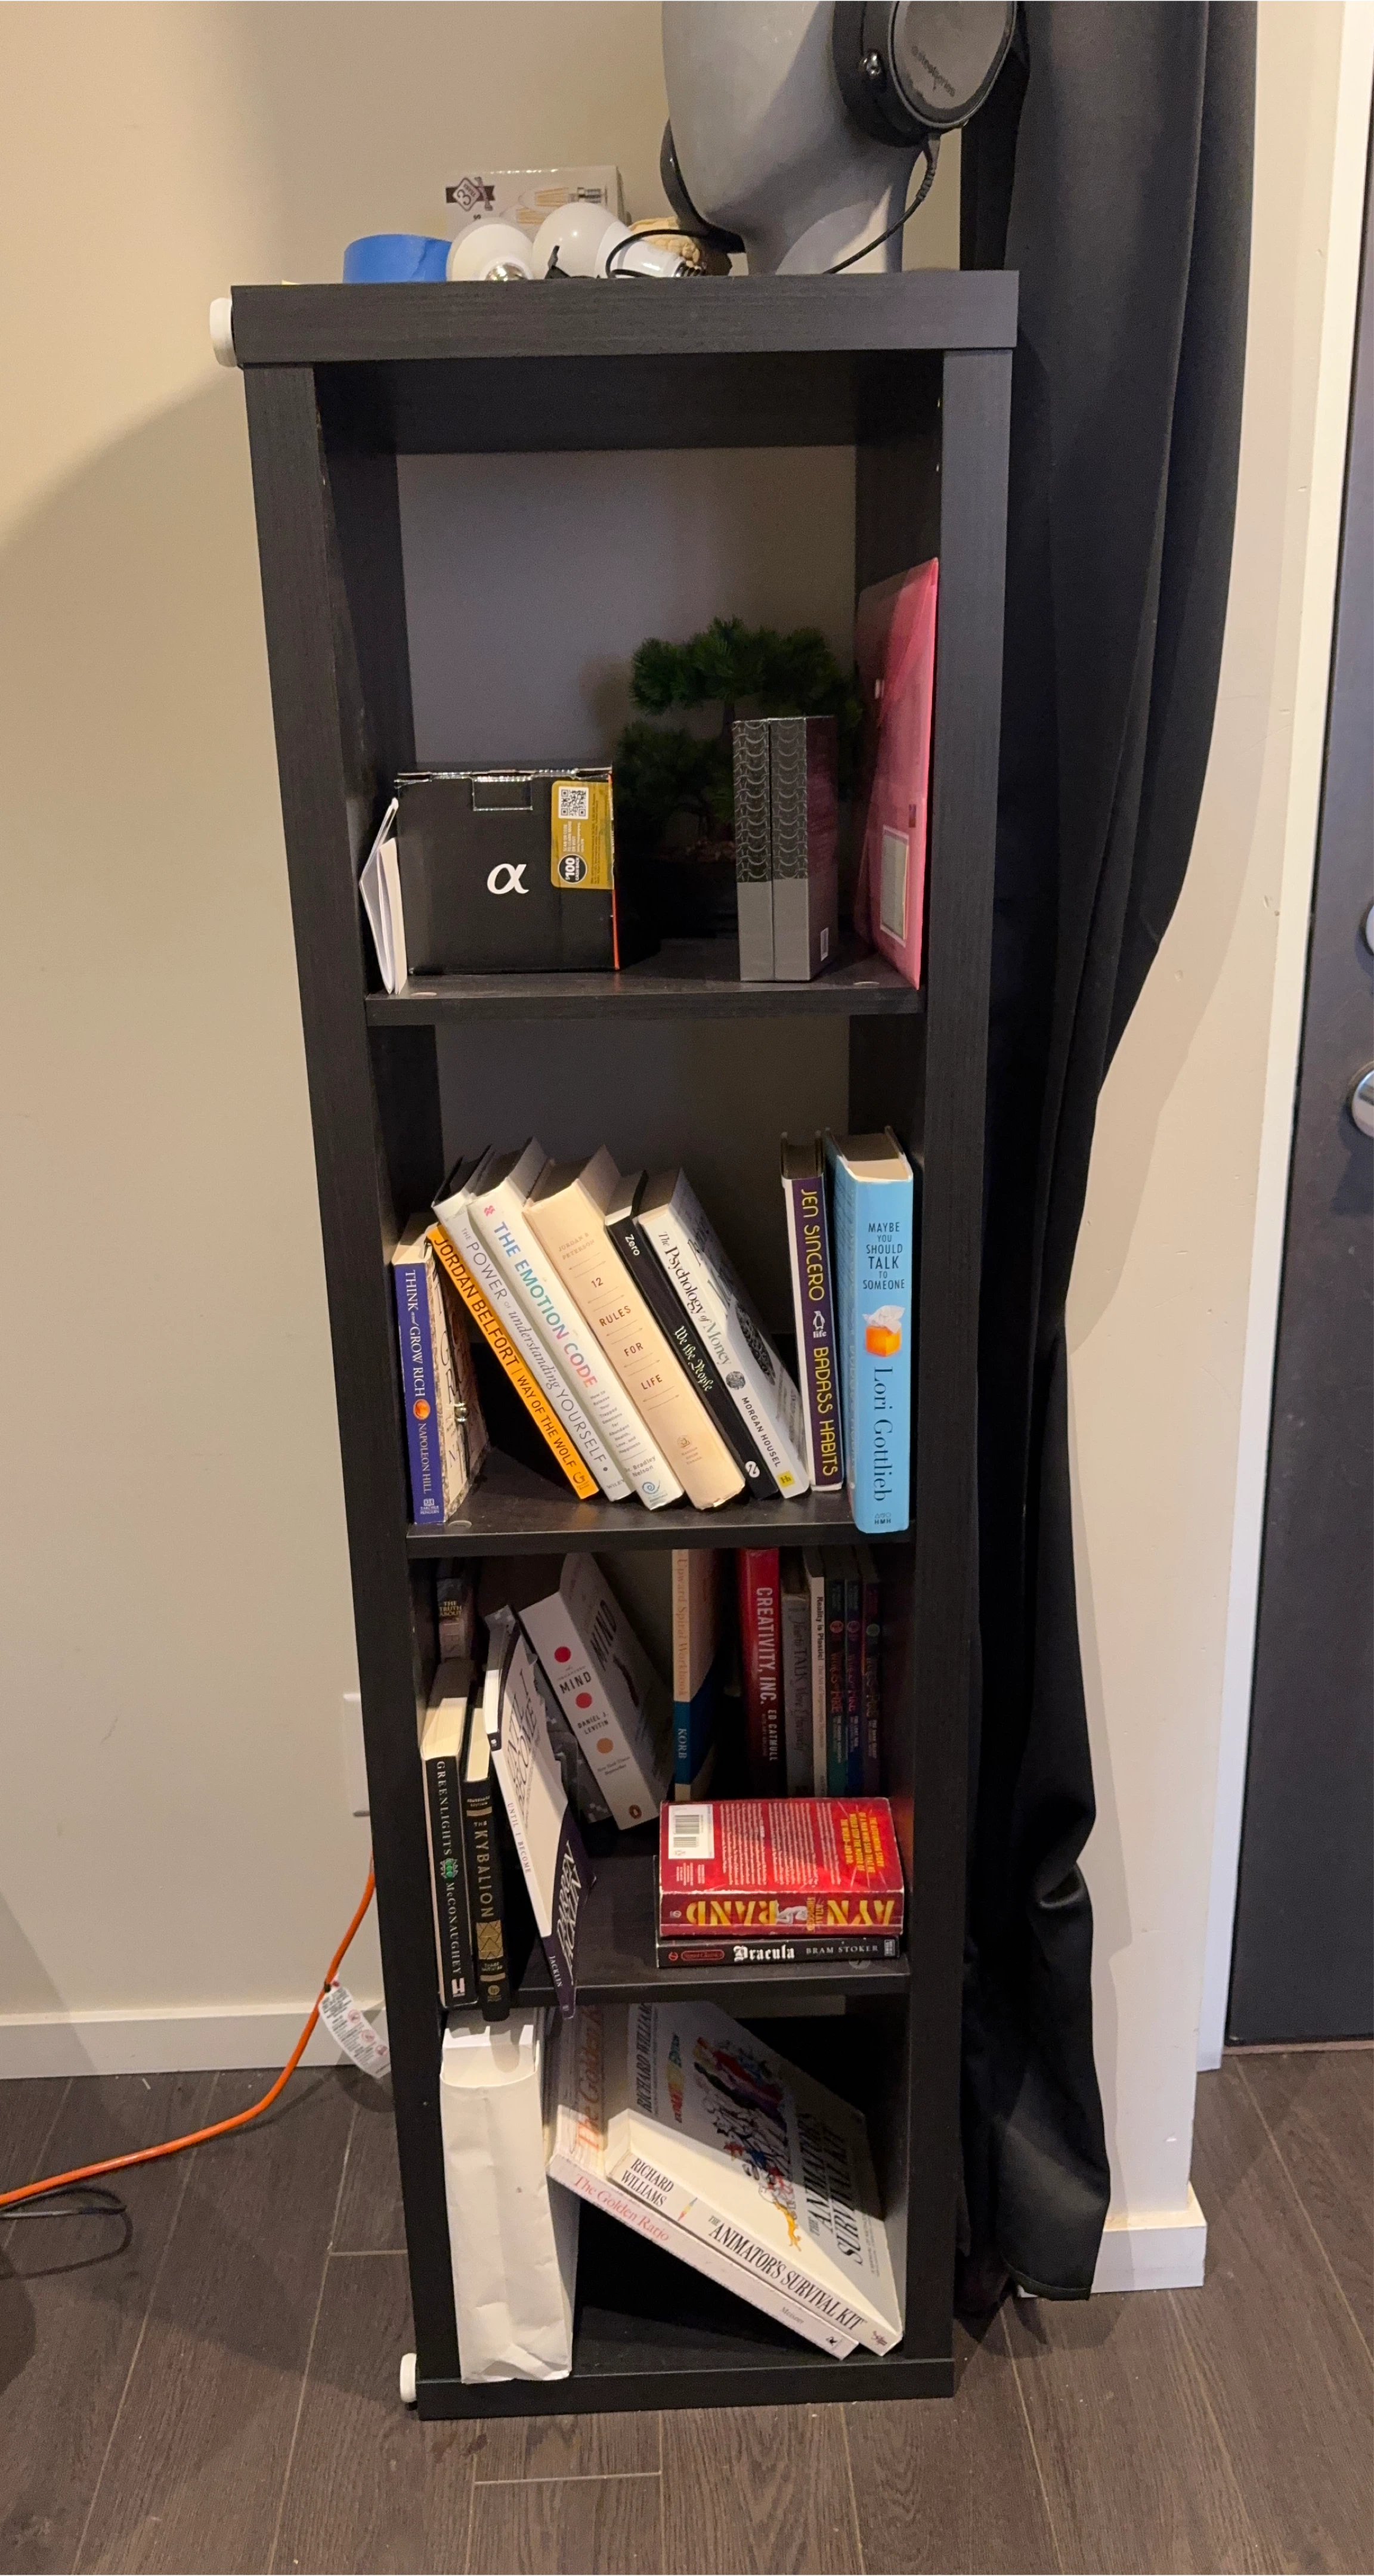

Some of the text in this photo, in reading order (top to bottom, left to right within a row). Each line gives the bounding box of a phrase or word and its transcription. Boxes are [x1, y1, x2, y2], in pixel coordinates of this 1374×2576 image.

[565, 857, 575, 880] $100
[461, 1227, 472, 1241] THE
[868, 1222, 900, 1233] MAYBE
[558, 1235, 584, 1252] JORDAN
[562, 1239, 595, 1260] PETERSON
[625, 1234, 640, 1256] Zero
[802, 1188, 825, 1301] JEN SINCERO
[866, 1243, 903, 1254] SHOULD
[466, 1241, 507, 1299] POWER
[868, 1256, 899, 1269] TALK
[591, 1277, 604, 1288] 12
[862, 1279, 905, 1290] SOMEONE
[494, 1221, 598, 1388] THE EMOTION CODE
[658, 1231, 731, 1366] The Psychology of Money
[599, 1305, 632, 1327] RULES
[406, 1270, 426, 1397] THINK GROW RICH
[434, 1239, 478, 1299] JORDAN
[471, 1299, 519, 1367] BELFORT
[517, 1375, 536, 1398] WAY
[531, 1400, 546, 1414] OF
[541, 1414, 559, 1438] THE
[553, 1438, 577, 1467] WOLF
[509, 1311, 561, 1391] understanding
[624, 1342, 643, 1357] FOR
[674, 1326, 714, 1392] We the People
[641, 1374, 663, 1390] LIFE
[813, 1346, 838, 1476] BADASS HABITS
[556, 1389, 606, 1462] YOURSELF
[741, 1397, 782, 1467] MORGAN HOUSEL
[873, 1367, 893, 1501] Lori Gottlieb
[419, 1423, 432, 1494] NAPOLEON HILL
[632, 1456, 656, 1470] Bradley
[632, 1465, 654, 1477] Nelson
[606, 1479, 625, 1489] WILEY
[816, 1596, 824, 1622] Reality
[590, 1599, 617, 1671] MIND
[676, 1558, 688, 1696] Upward Spiral Workbook
[756, 1587, 776, 1705] CREATIVITY, INC.
[794, 1647, 809, 1682] TALK
[559, 1671, 592, 1693] MIND
[577, 1714, 601, 1729] DANIEL
[584, 1720, 609, 1735] LEVITIN
[677, 1727, 688, 1759] KORB
[768, 1710, 778, 1761] ED CATMULL
[437, 1761, 452, 1855] GREENLIGHTS
[849, 1813, 858, 1828] WOULD
[840, 1819, 849, 1827] THE
[852, 1828, 860, 1839] STOP
[860, 1822, 868, 1831] MAN
[507, 1803, 518, 1827] UNTIL
[518, 1840, 531, 1874] BECOME
[862, 1832, 870, 1843] WHO
[864, 1843, 872, 1853] SAID
[855, 1848, 864, 1864] MOTOR
[865, 1854, 874, 1866] THAT
[875, 1852, 885, 1867] STORY
[474, 1830, 494, 1918] KYBALION
[686, 1900, 777, 1926] RAND
[827, 1900, 895, 1926] AYN
[446, 1882, 462, 1974] McCONAUGHEY
[733, 1945, 795, 1962] Dracula
[838, 1944, 878, 1953] STOKER
[549, 1956, 563, 1987] JACKLIN
[578, 2027, 600, 2103] Golden
[636, 2054, 652, 2113] RICHARD
[576, 2106, 600, 2149] The
[621, 2170, 667, 2207] WILLIAMS
[631, 2158, 674, 2193] RICHARD
[573, 2174, 670, 2241] The Golden Ratio
[809, 2216, 820, 2236] THE
[708, 2215, 866, 2331] THE ANIMATOR'S SURVIVAL KIT
[780, 2306, 804, 2324] Meisner
